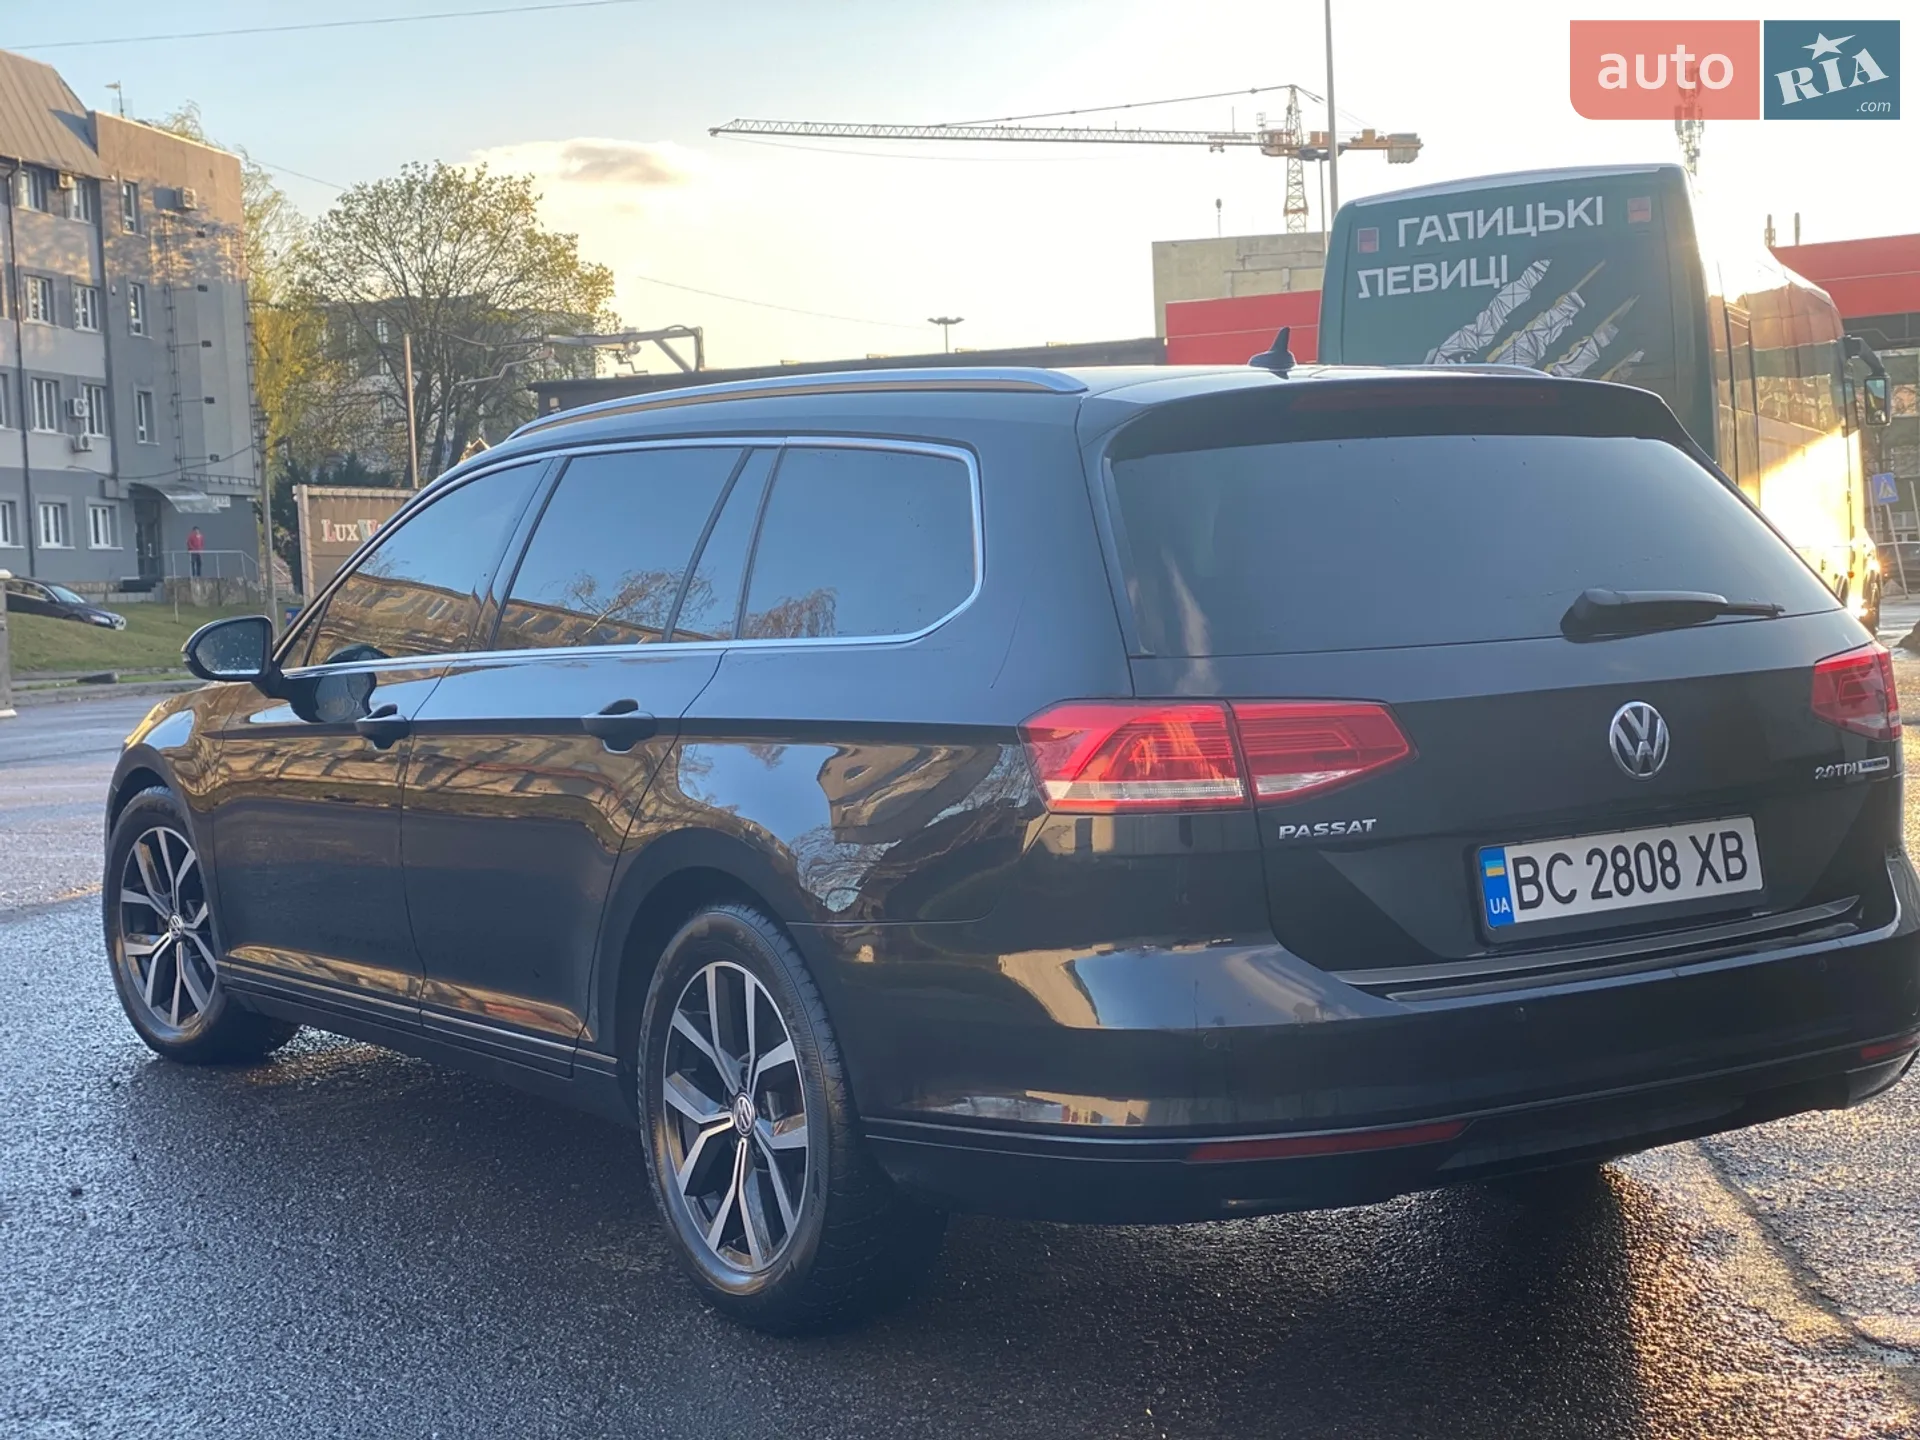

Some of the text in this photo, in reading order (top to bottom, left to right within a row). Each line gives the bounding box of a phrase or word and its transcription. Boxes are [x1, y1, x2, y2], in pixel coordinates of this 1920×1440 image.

[1398, 196, 1603, 247] ГАЛИЦЬКІ
[1358, 254, 1508, 298] ЛЕВИЦІ
[1279, 819, 1377, 839] PASSAT
[1512, 830, 1748, 910] BC 2808 XB
[1490, 897, 1510, 914] UA
